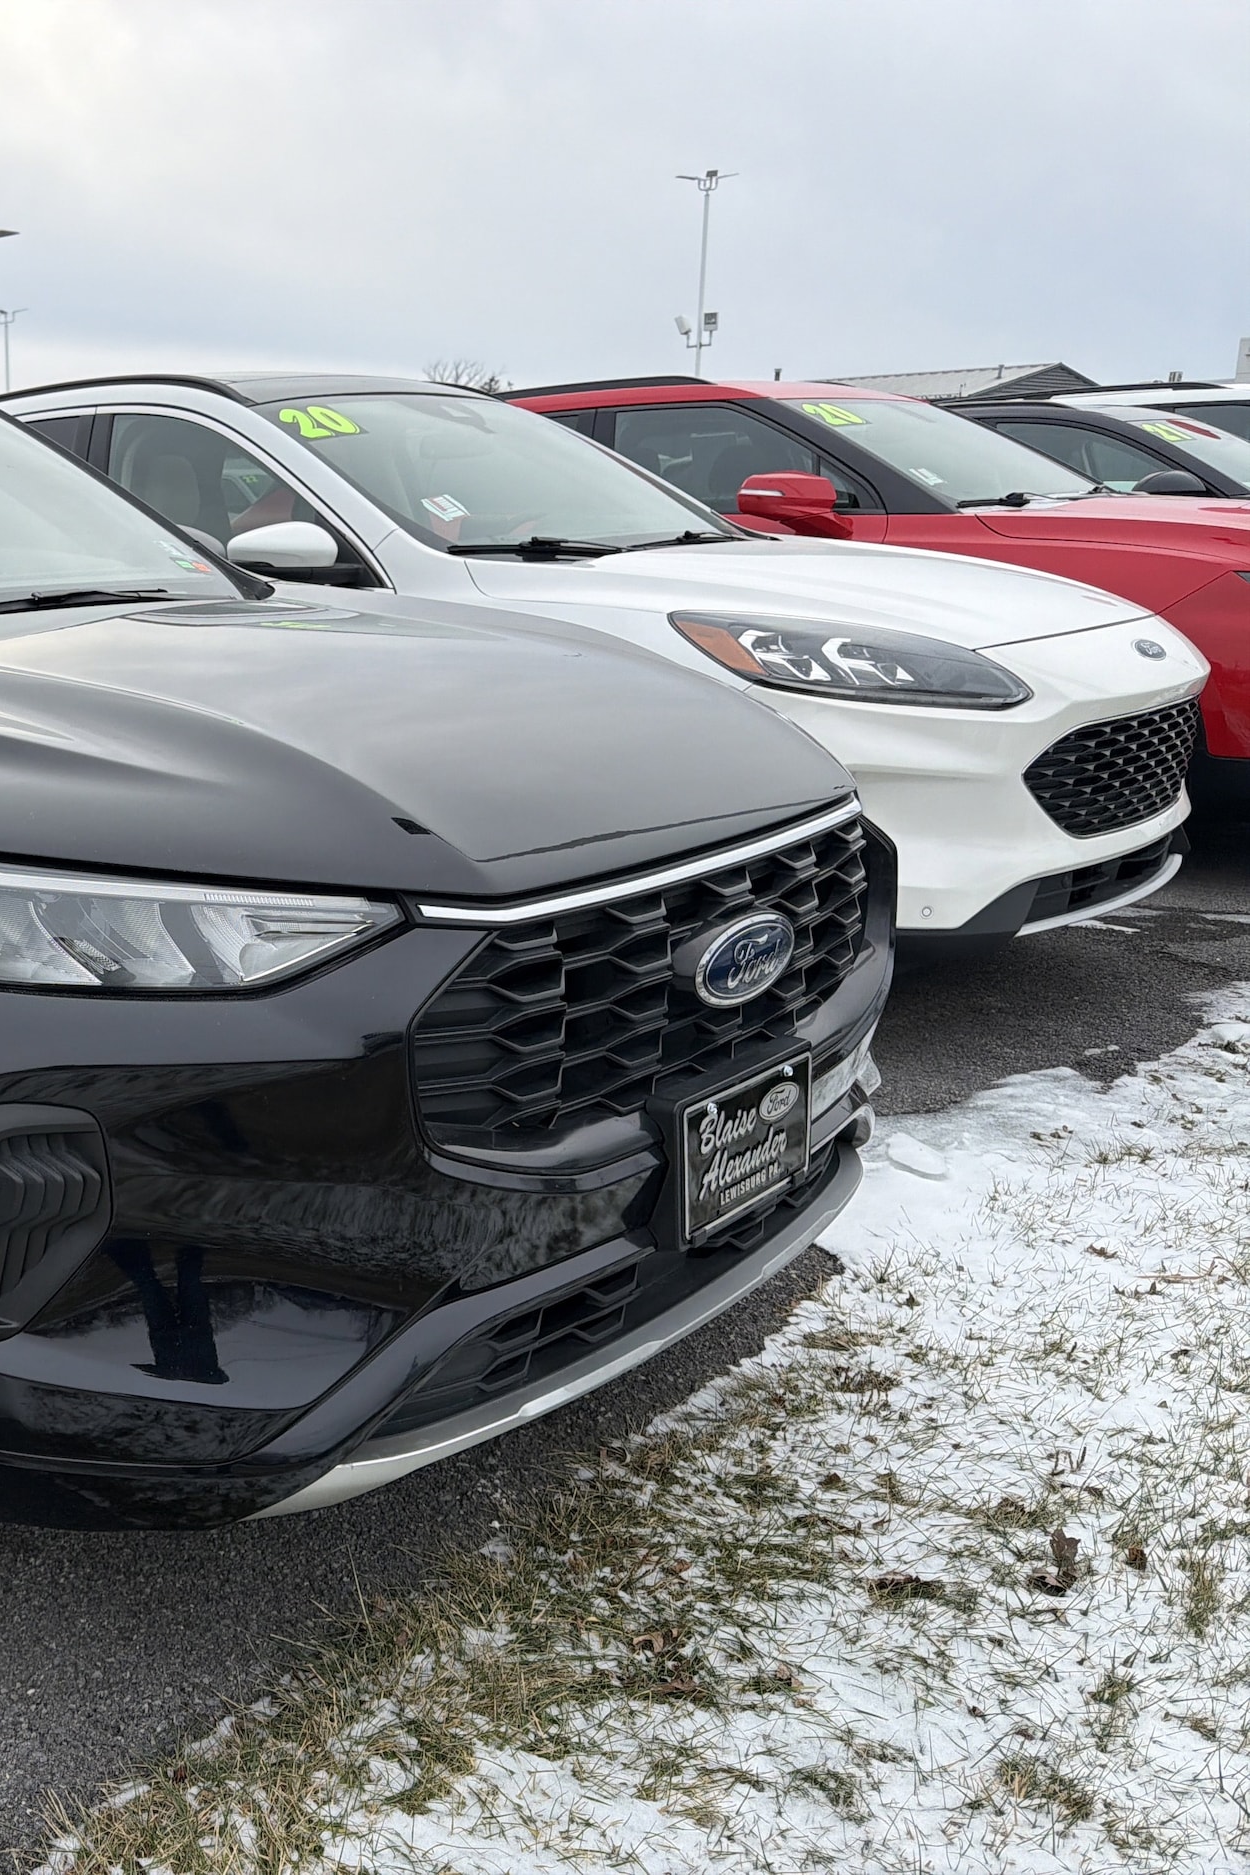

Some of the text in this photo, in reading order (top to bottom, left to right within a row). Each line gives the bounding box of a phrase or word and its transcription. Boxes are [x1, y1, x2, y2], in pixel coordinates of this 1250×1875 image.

[279, 406, 360, 438] 20
[802, 403, 867, 425] 20
[727, 933, 781, 989] Ford
[766, 1088, 791, 1115] Ford
[699, 1107, 757, 1155] Blaise
[699, 1126, 788, 1200] Alexander
[720, 1169, 767, 1206] LEWISBURG
